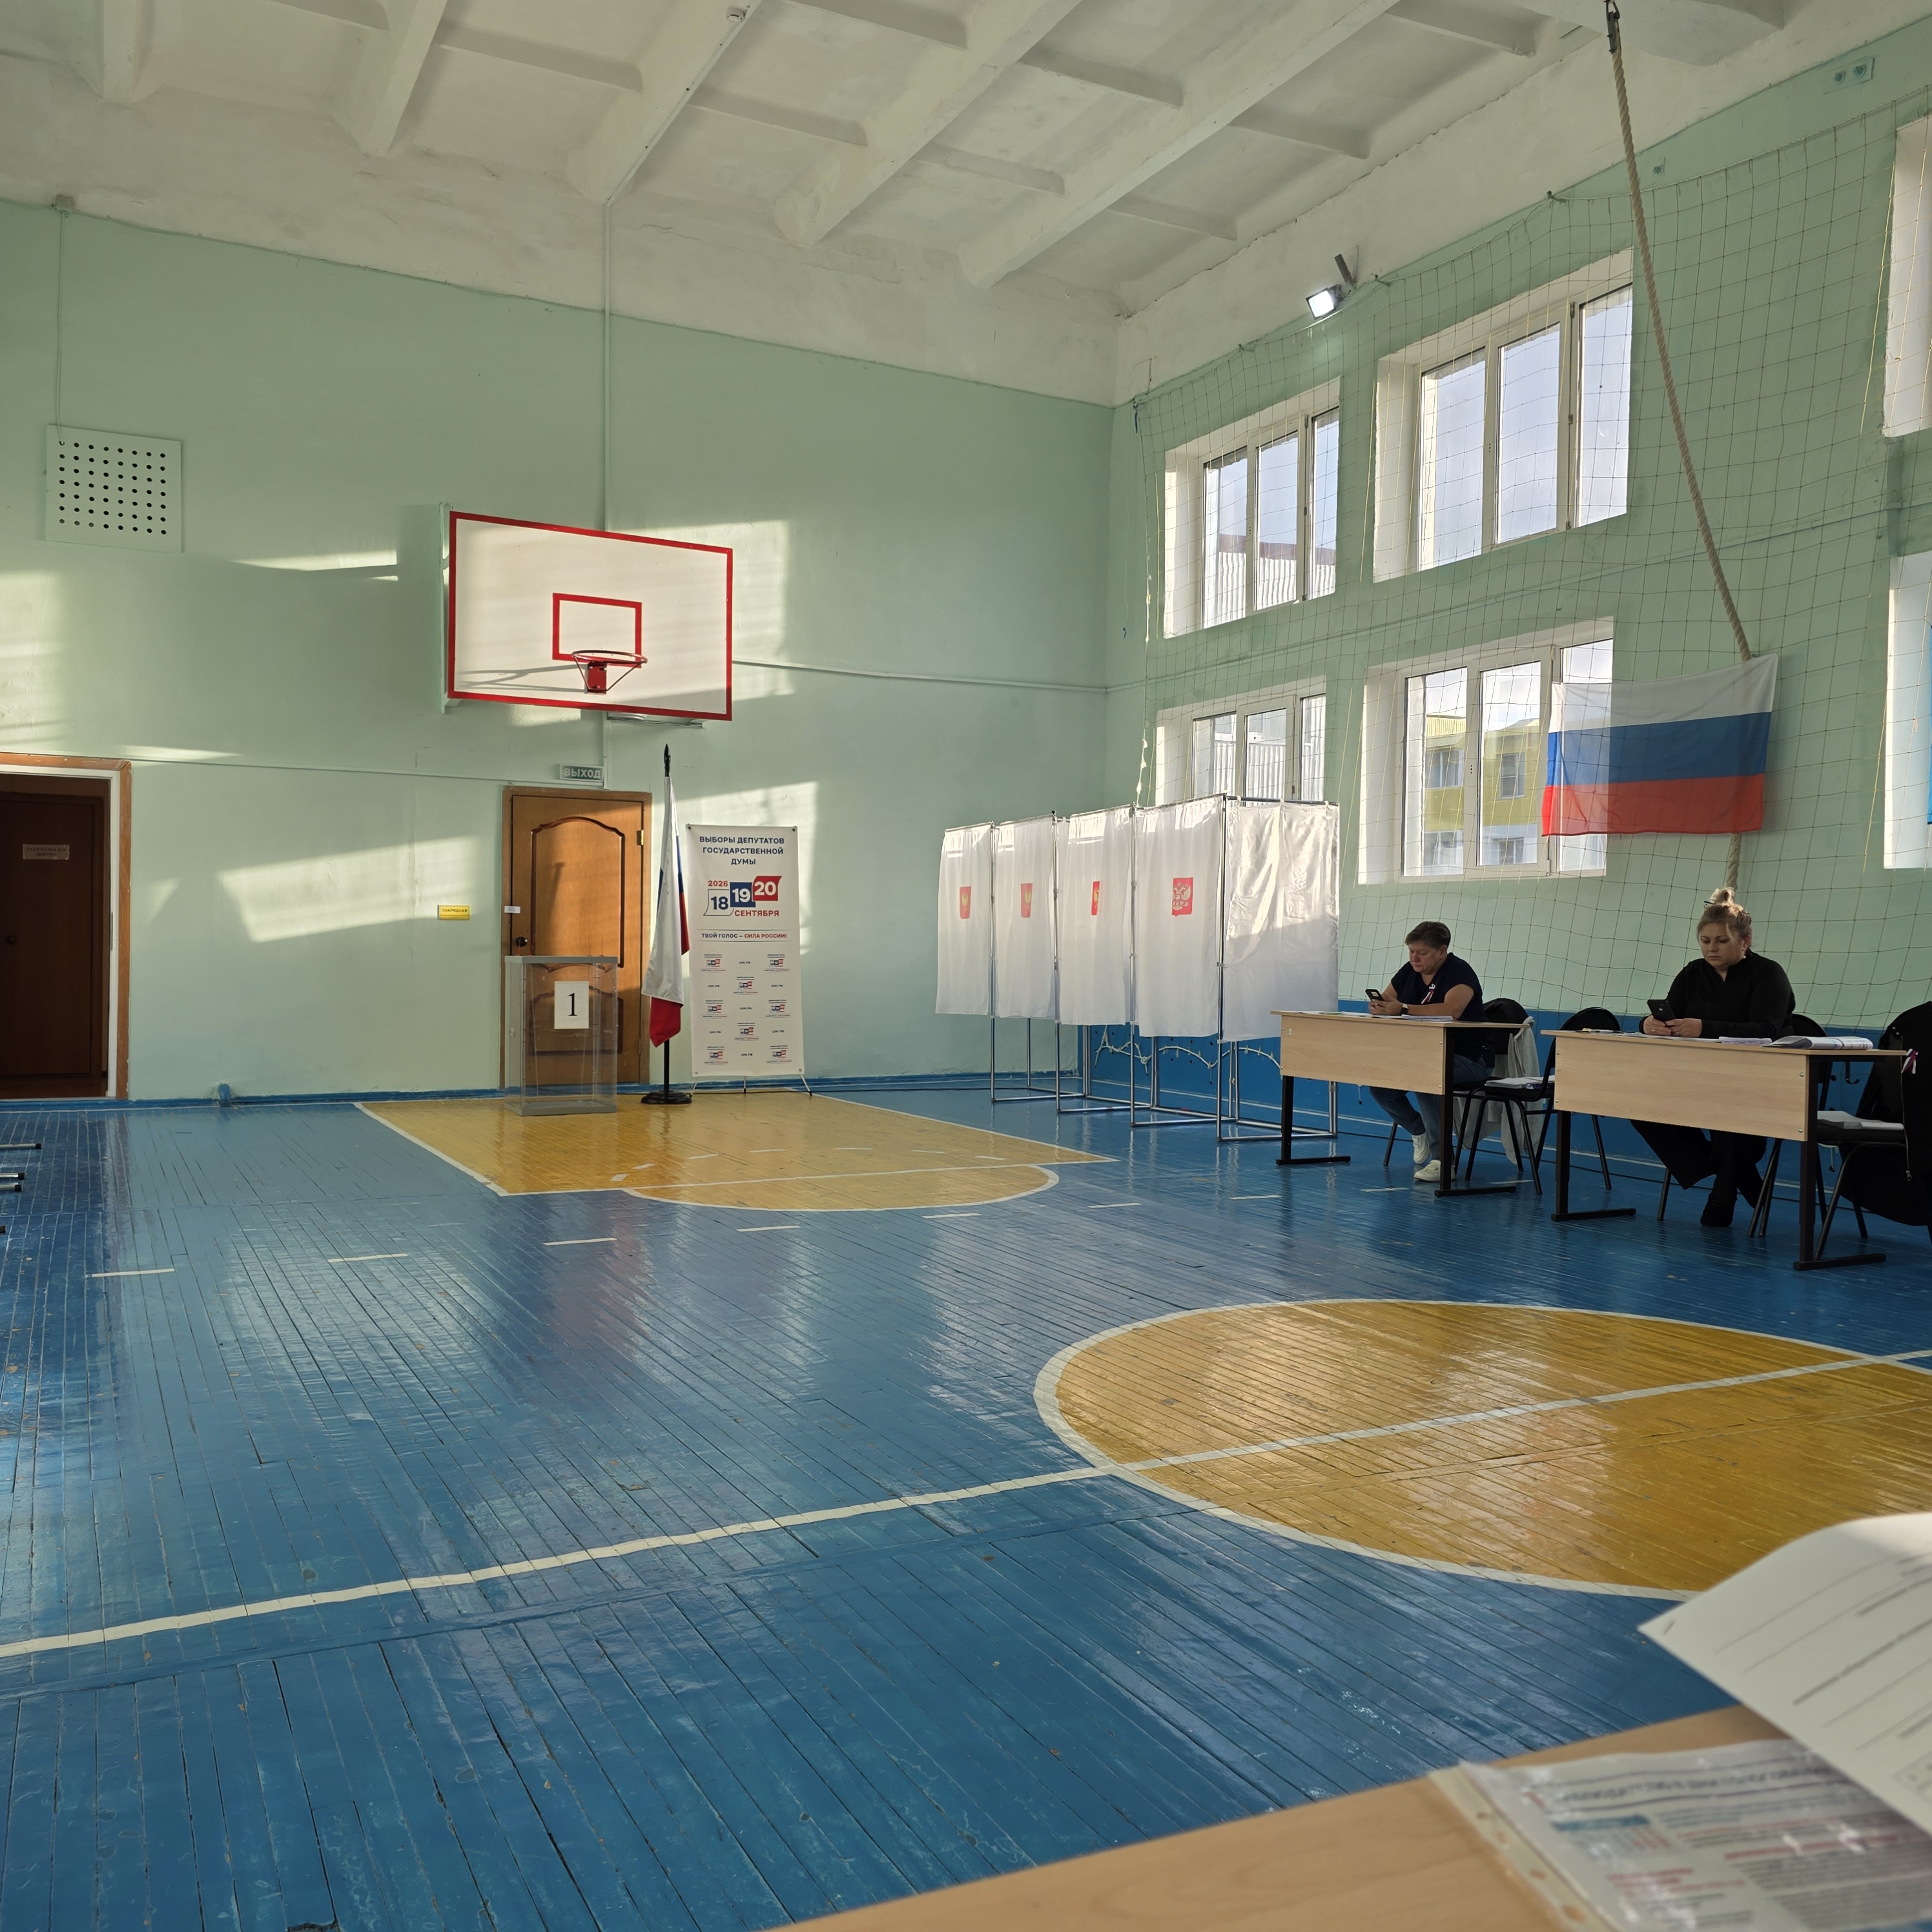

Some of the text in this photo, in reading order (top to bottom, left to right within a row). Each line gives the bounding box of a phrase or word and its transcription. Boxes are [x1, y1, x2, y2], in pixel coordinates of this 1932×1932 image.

[564, 768, 601, 779] ВЫХОД
[703, 847, 783, 855] ГОСУДАРСТВЕННОЙ
[710, 881, 777, 910] 18 19 20
[568, 992, 577, 1016] 1
